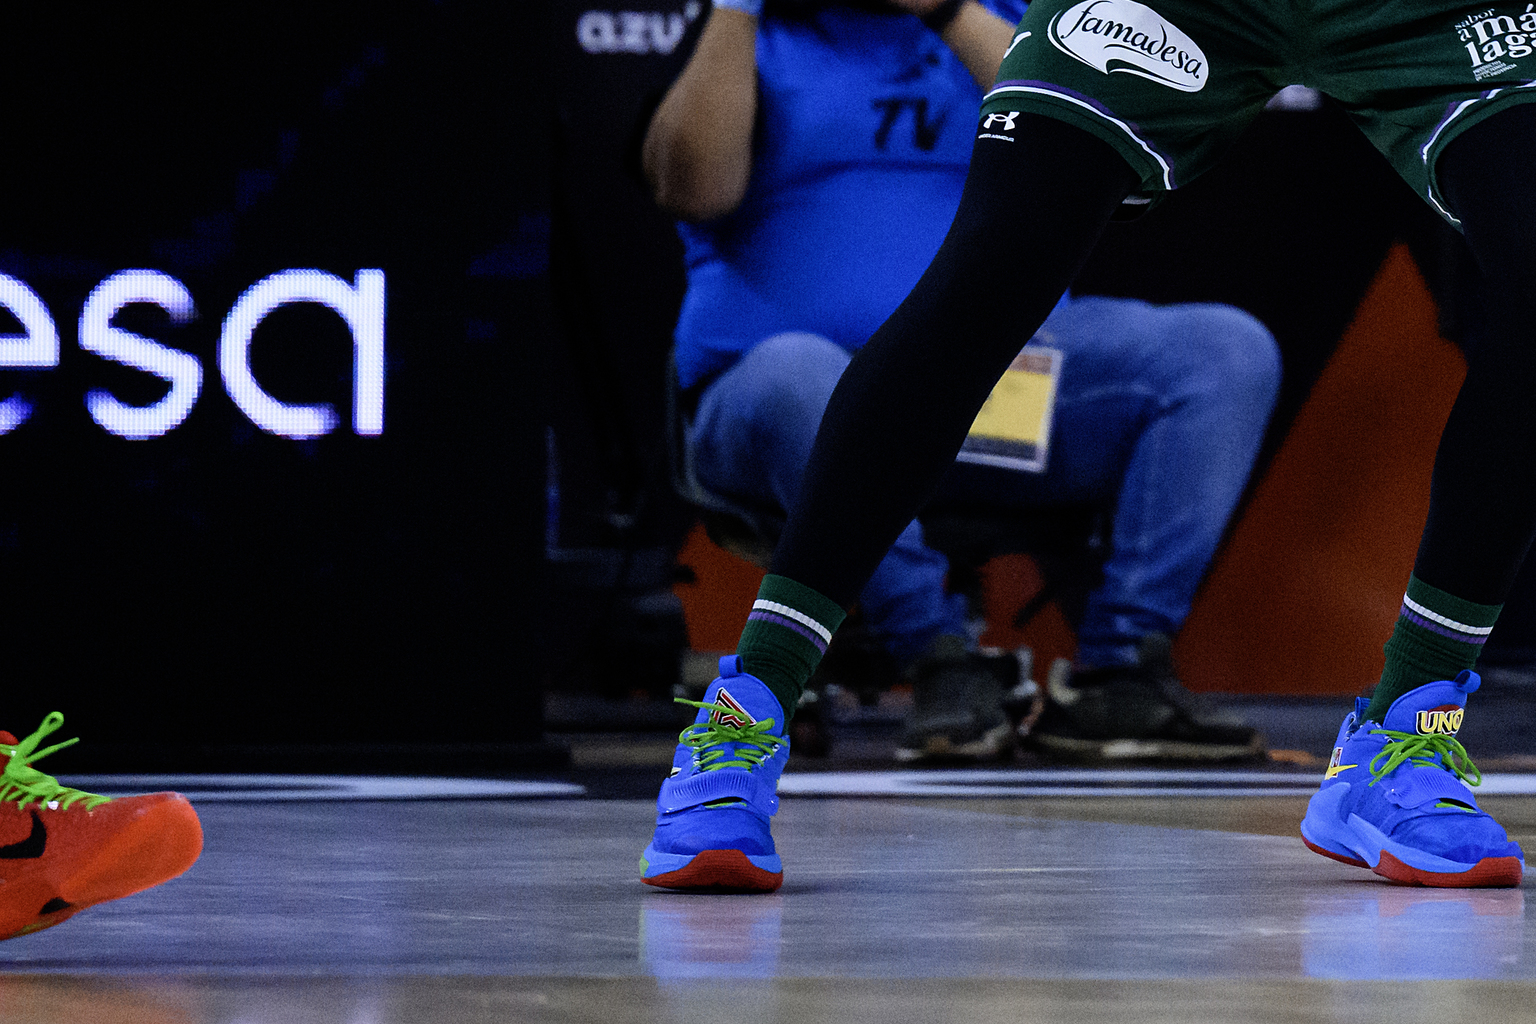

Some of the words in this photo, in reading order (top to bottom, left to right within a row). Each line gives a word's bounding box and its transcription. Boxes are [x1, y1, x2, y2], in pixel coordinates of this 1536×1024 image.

[577, 0, 700, 55] azu
[1061, 0, 1202, 80] famadesa
[1416, 708, 1464, 735] UNO
